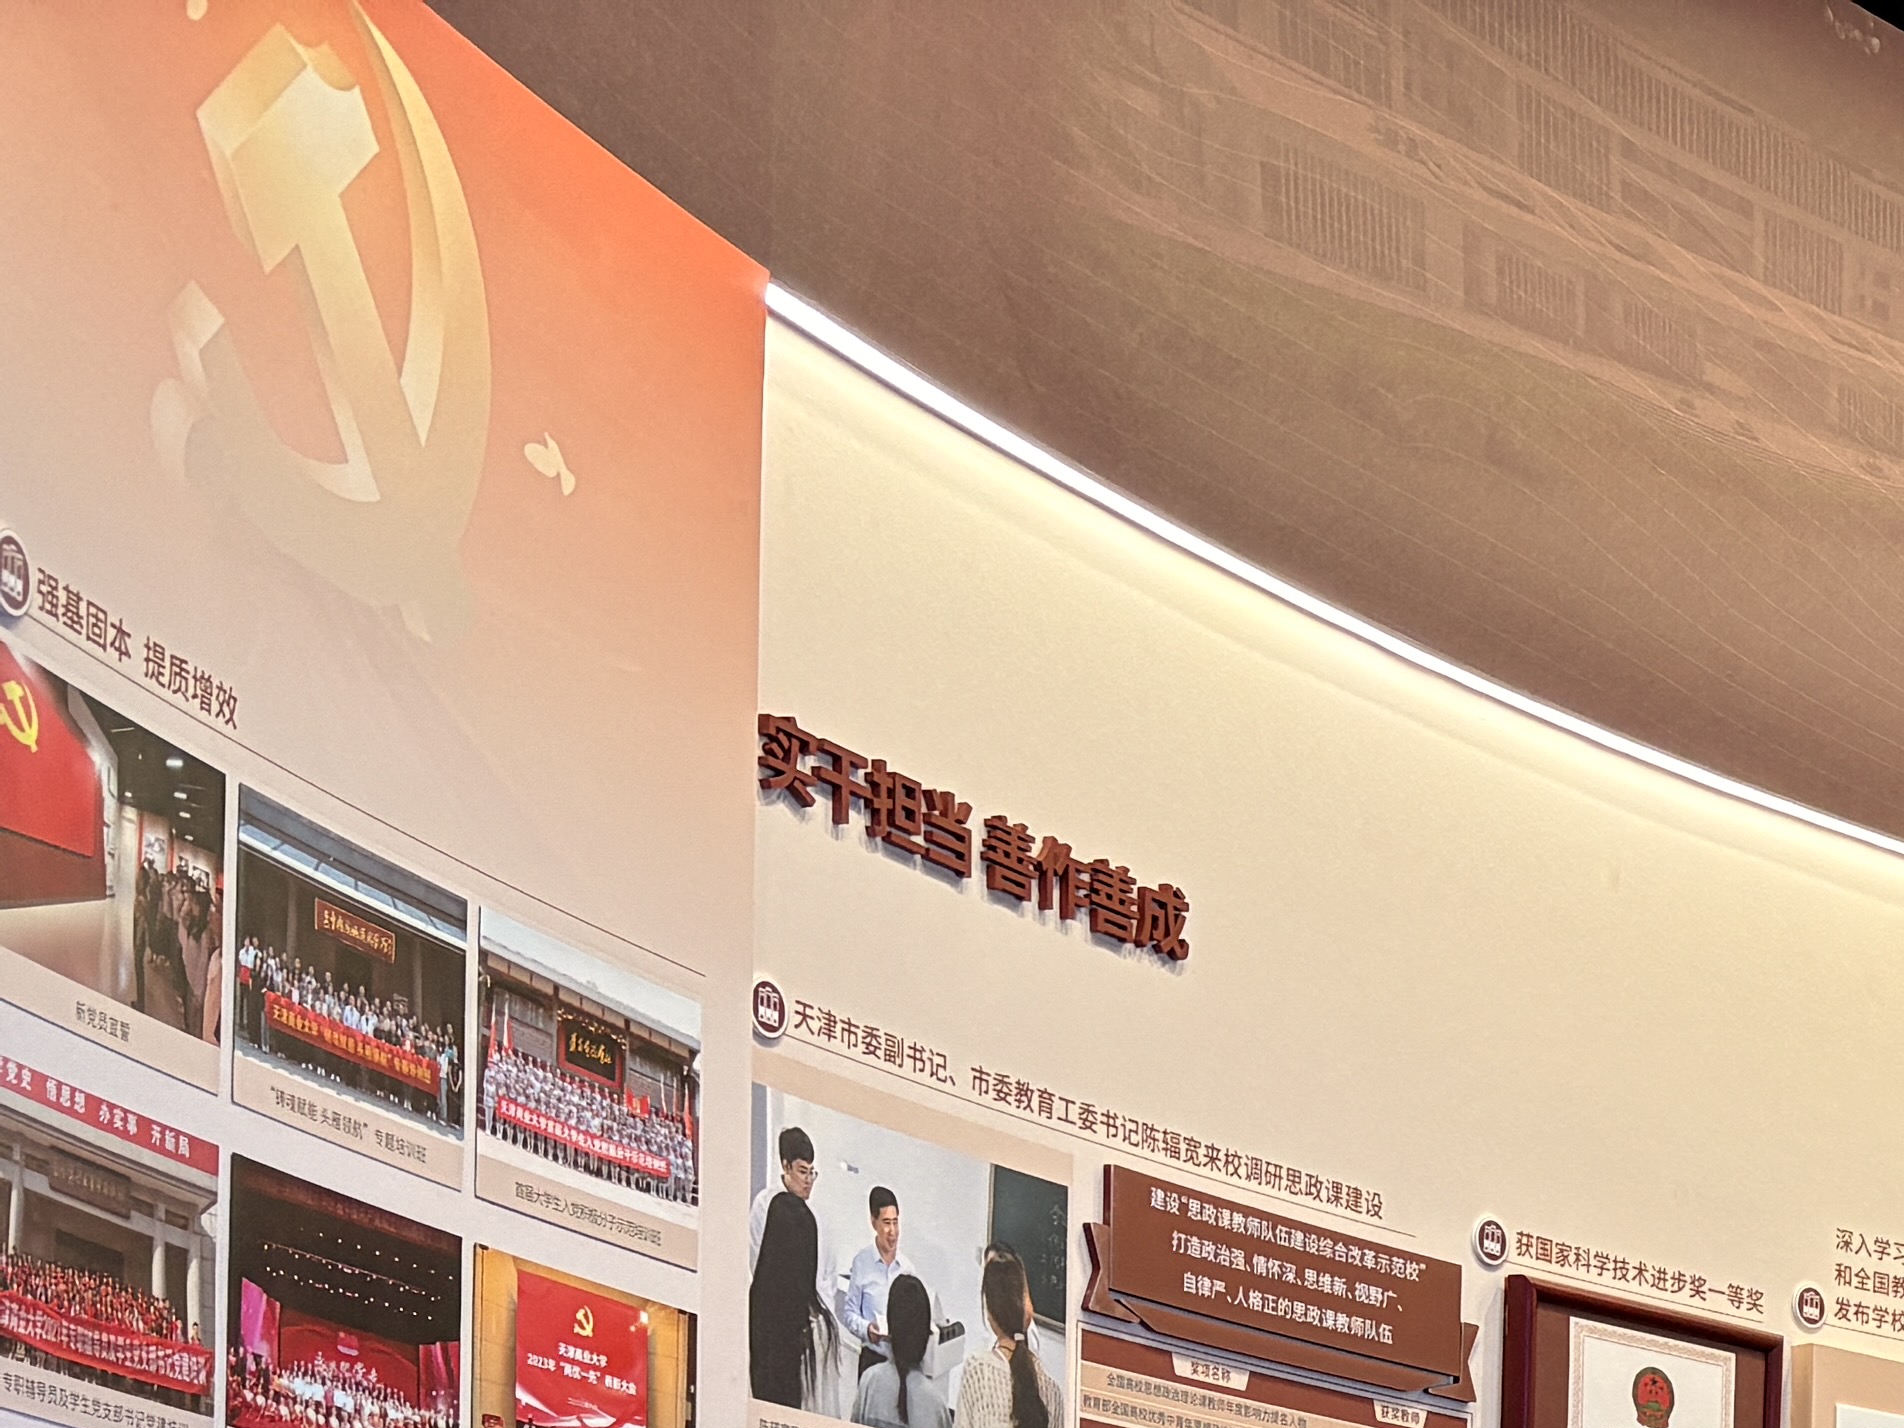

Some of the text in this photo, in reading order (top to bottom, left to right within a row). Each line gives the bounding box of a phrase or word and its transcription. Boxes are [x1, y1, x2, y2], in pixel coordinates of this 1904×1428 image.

[36, 568, 238, 730] 强基固本 提质增效
[758, 714, 1189, 960] 实干担当 善作善成
[99, 1101, 138, 1135] 办实事
[151, 1125, 190, 1158] 开新局
[794, 999, 1384, 1220] 天津市委副书记、市委教育工委书记陈辐宽来校调研思政课建设
[1150, 1187, 1426, 1282] 建设“思政课教师队伍建设综合改革示范校”
[1516, 1230, 1763, 1316] 获国家科学技术进步奖一等奖
[1183, 1272, 1393, 1345] 自律严、人格正的思政课教师队伍
[1191, 1362, 1420, 1425] 奖项名称 获奖教师
